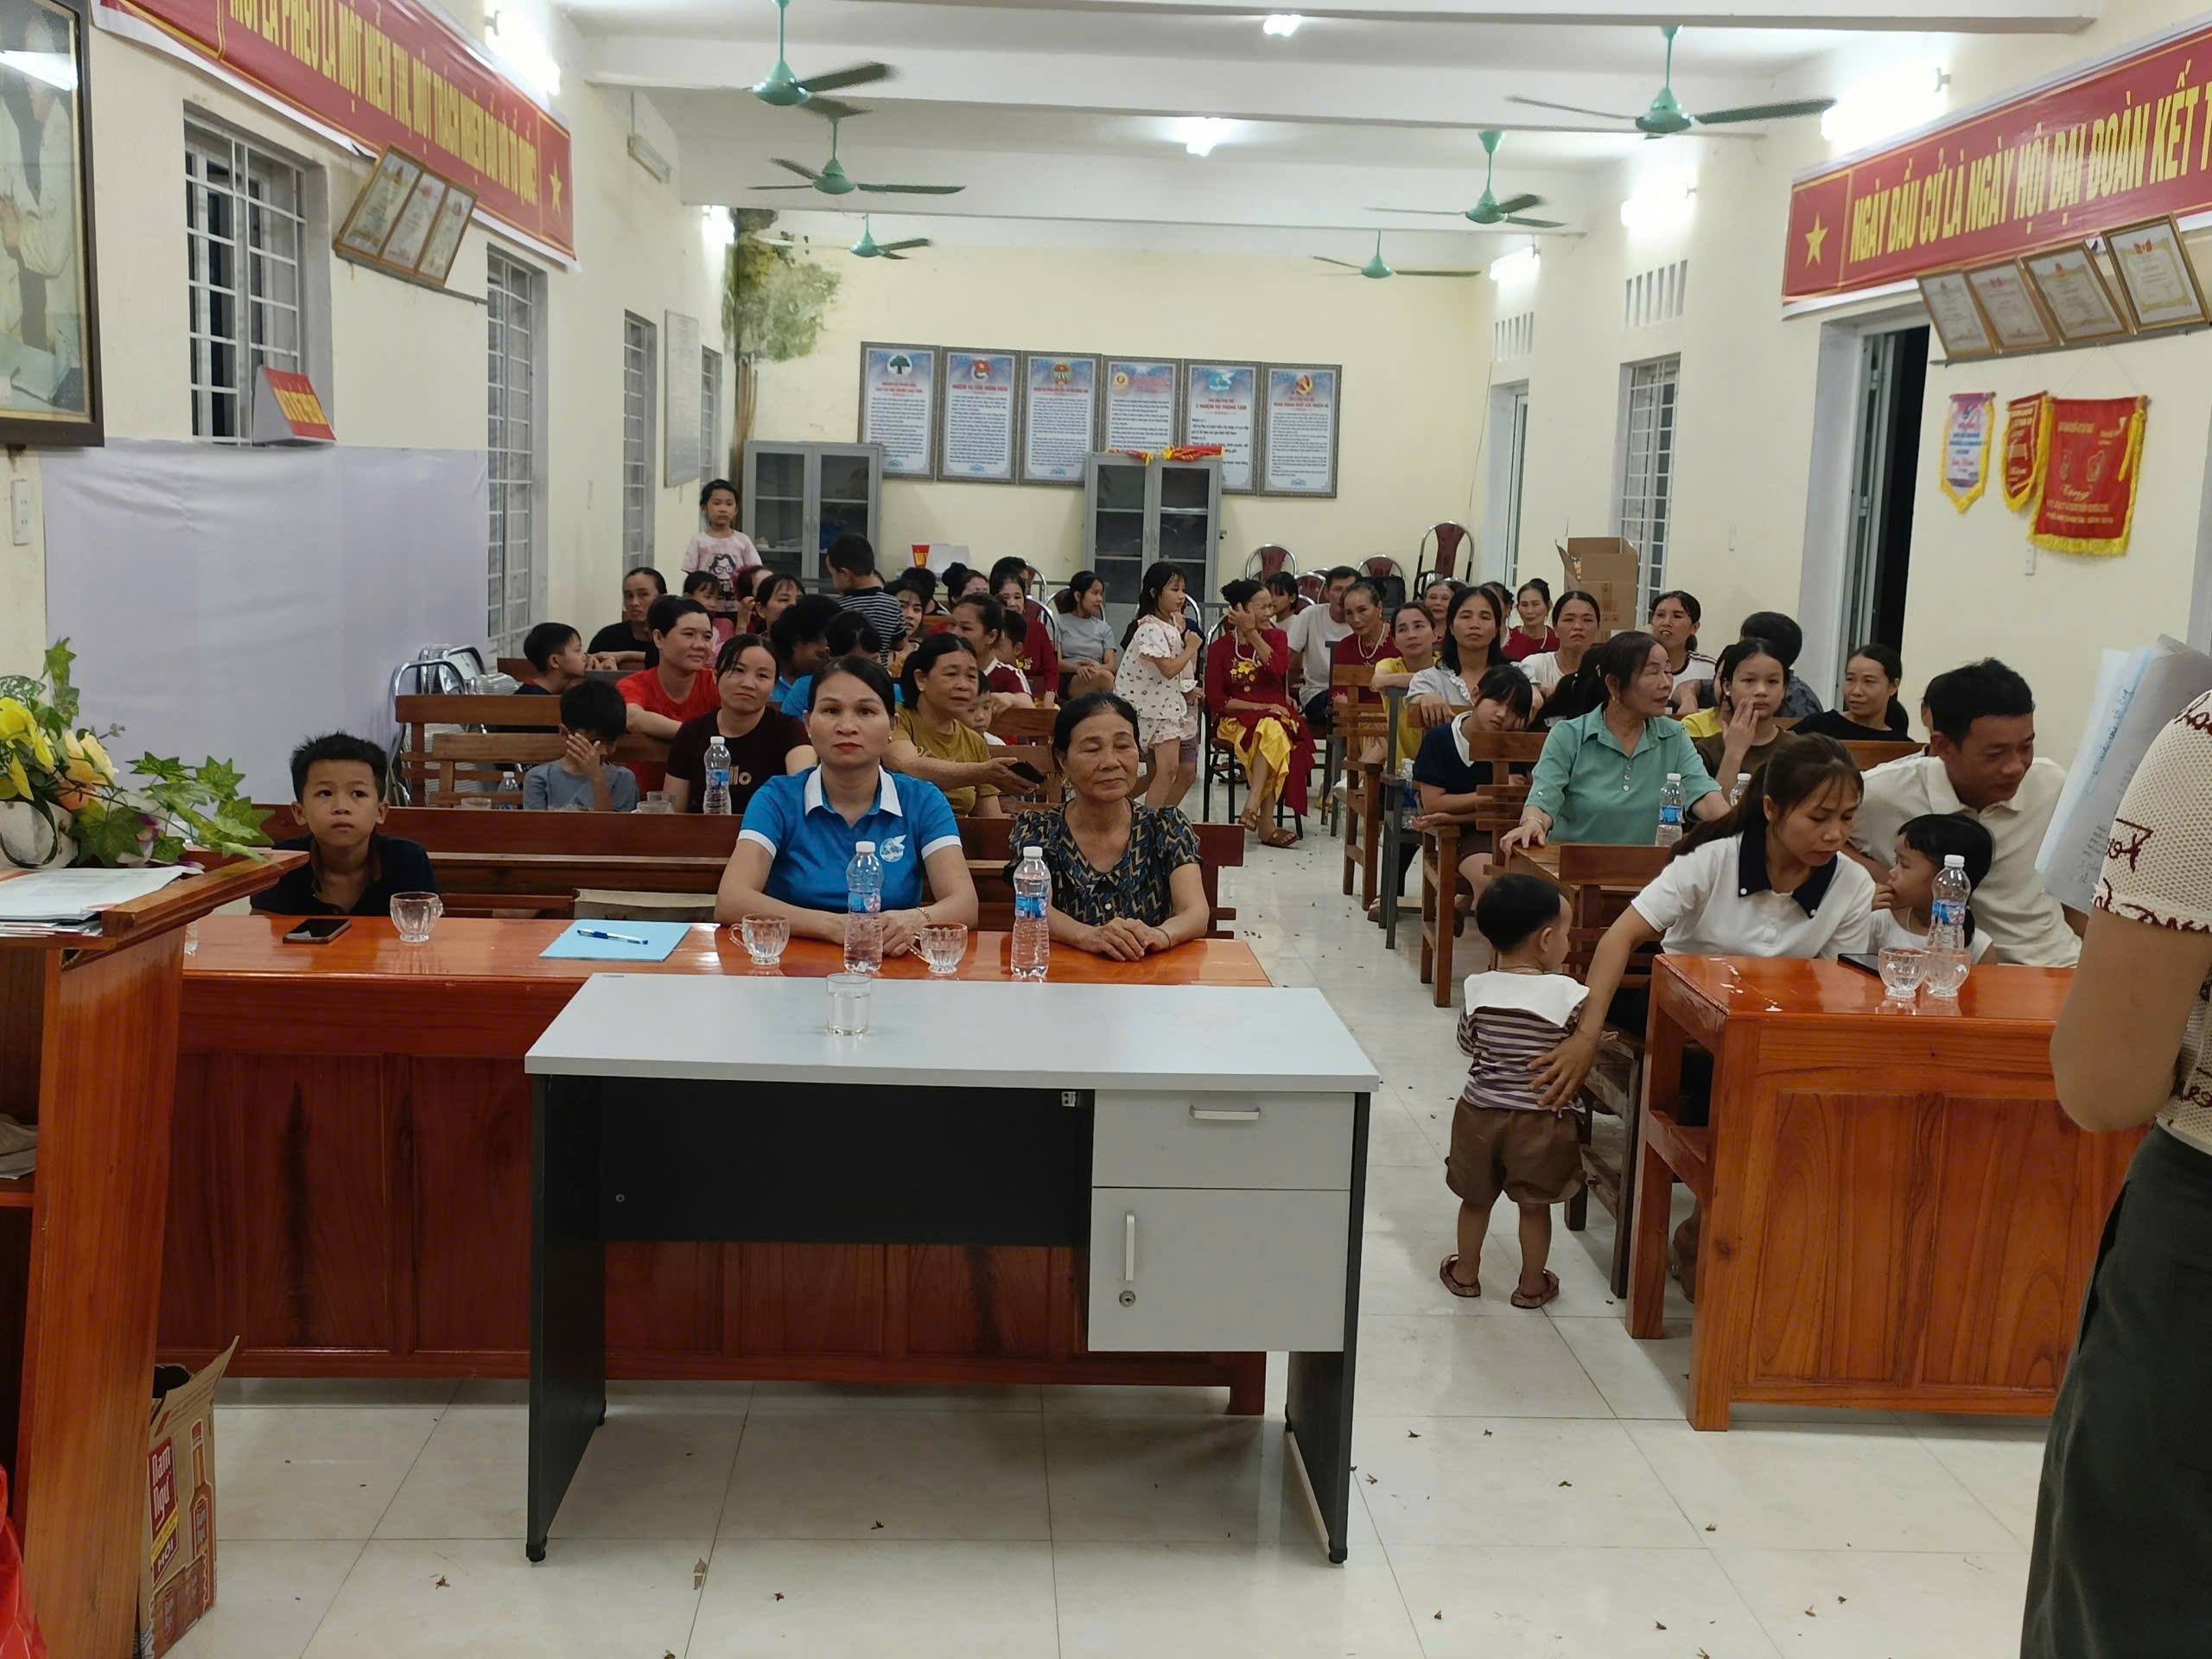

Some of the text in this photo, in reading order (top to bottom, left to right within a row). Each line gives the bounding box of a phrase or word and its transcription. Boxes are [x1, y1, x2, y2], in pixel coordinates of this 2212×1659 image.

[1850, 178, 1891, 263] NGÀY
[1887, 157, 1921, 254] BẦU
[1919, 147, 1947, 245] CỬ
[1942, 149, 1964, 238] LÀ
[1965, 136, 2015, 233] NGÀY
[2013, 122, 2050, 234] HỘI
[2049, 123, 2087, 226] ĐẠI
[2086, 90, 2151, 201] ĐOÀN
[2149, 59, 2200, 184] KẾT
[151, 1446, 171, 1487] Nam
